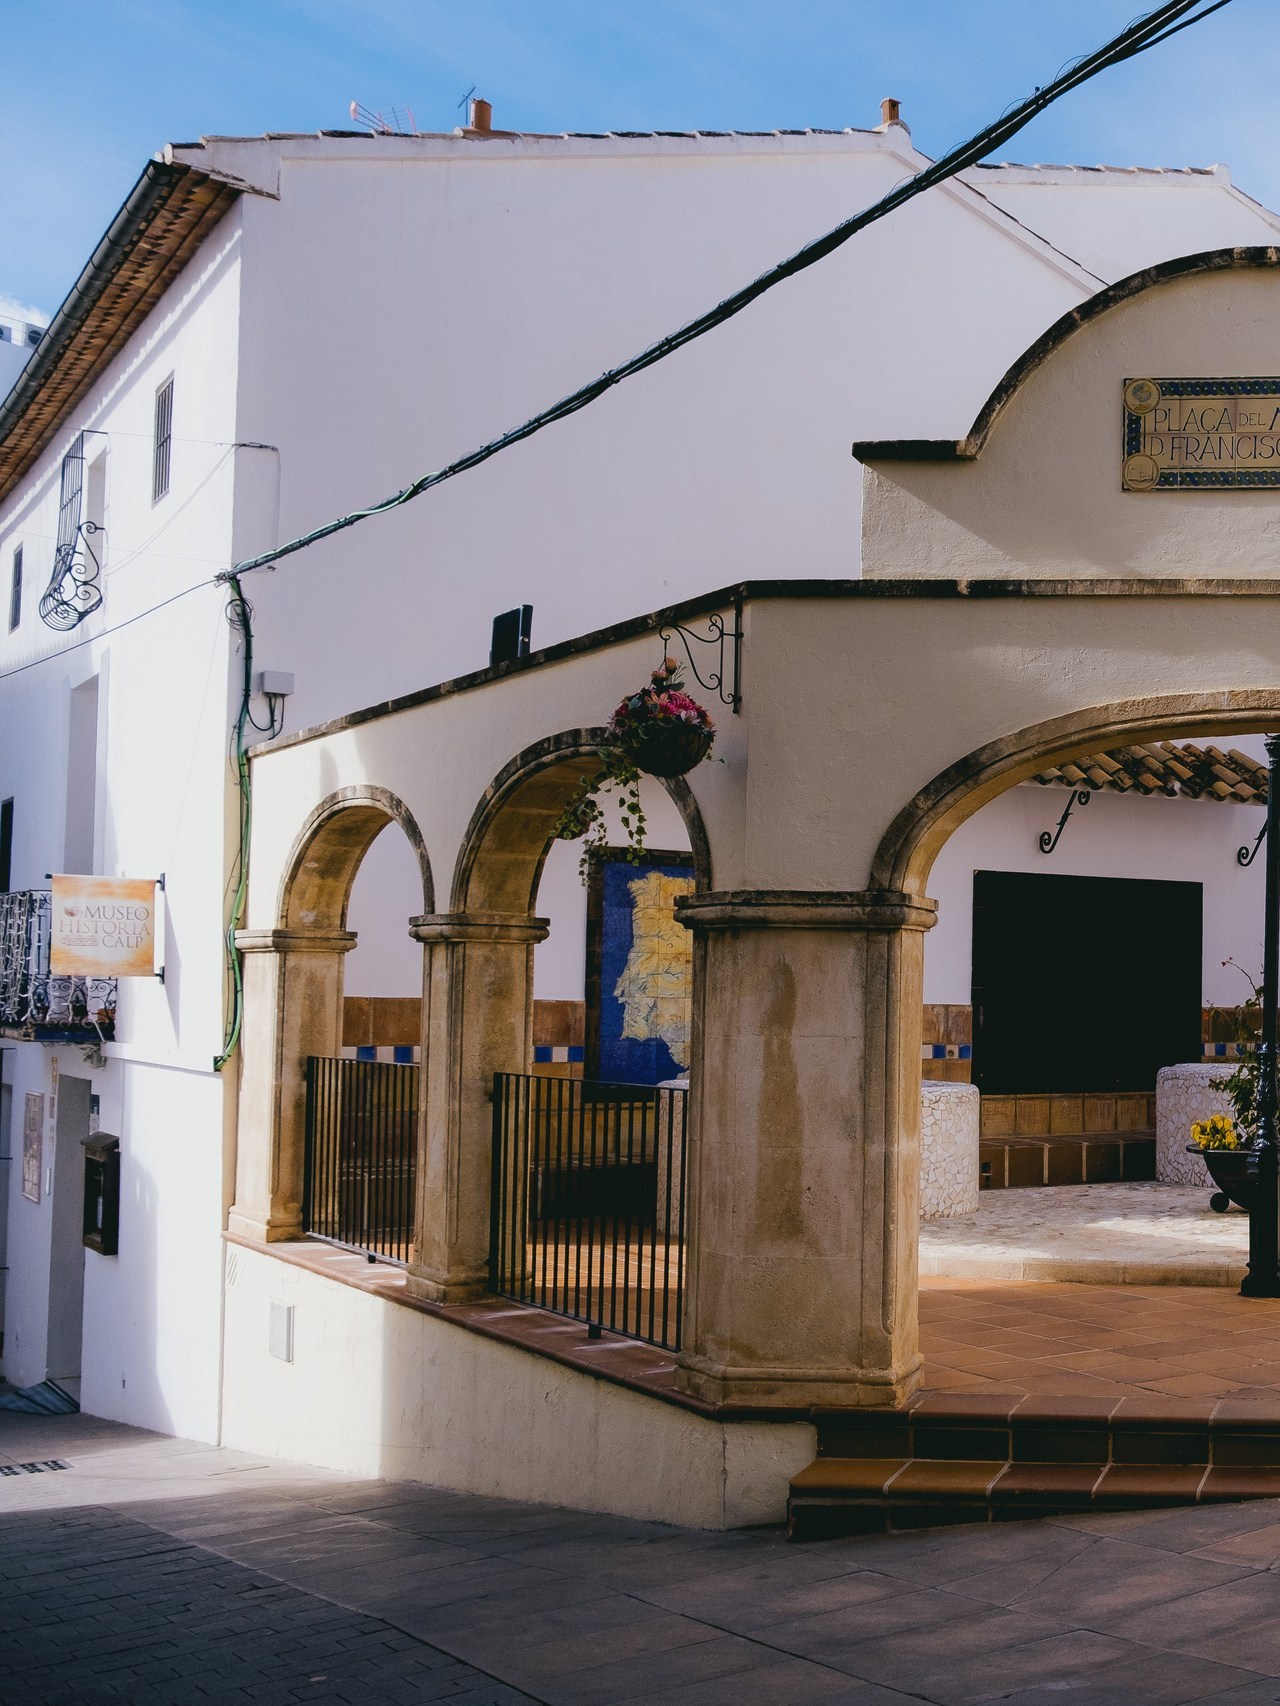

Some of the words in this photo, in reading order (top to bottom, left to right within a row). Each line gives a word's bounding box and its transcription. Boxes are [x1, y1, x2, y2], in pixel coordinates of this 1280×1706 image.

[1153, 406, 1234, 434] PLAÇA
[1239, 412, 1266, 426] DEL
[1149, 437, 1164, 457] D.
[84, 905, 149, 921] MUSEO
[59, 919, 151, 935] HISTORIA
[101, 935, 143, 948] CALP
